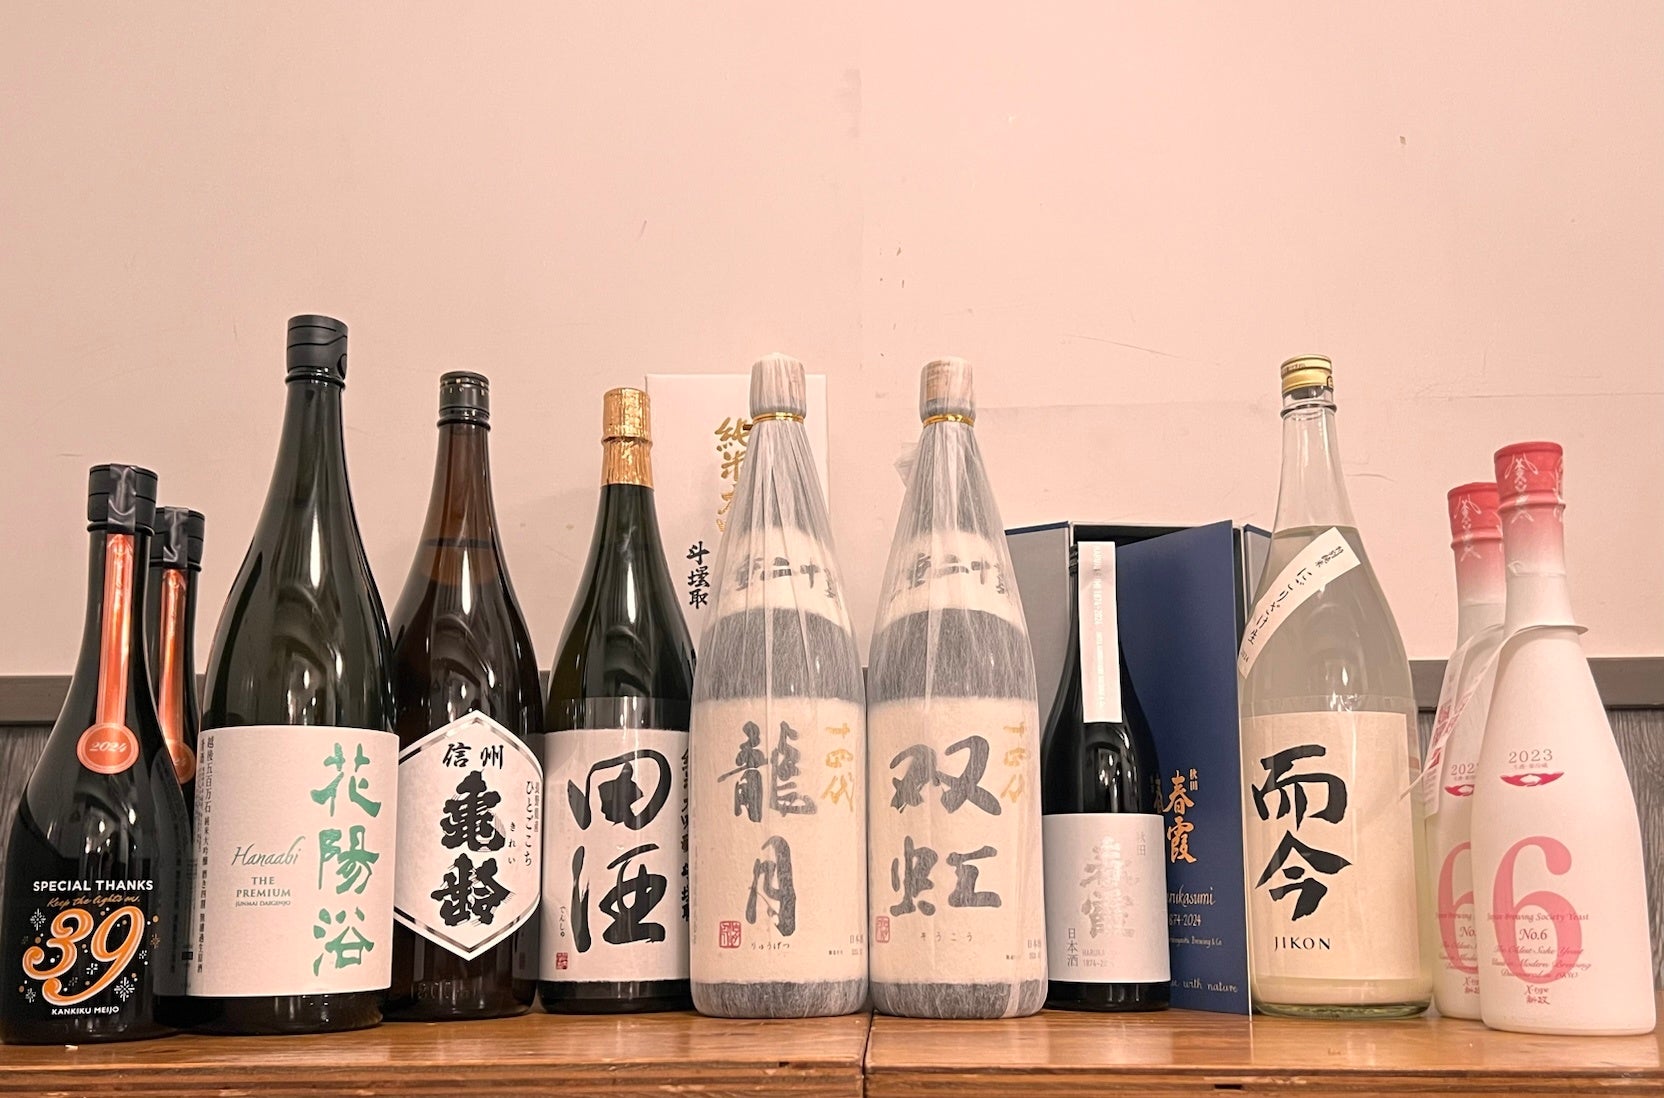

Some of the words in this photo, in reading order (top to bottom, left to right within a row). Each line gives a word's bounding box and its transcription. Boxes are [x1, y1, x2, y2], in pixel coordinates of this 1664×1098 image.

[89, 741, 129, 753] 2024
[442, 742, 505, 770] 信州
[1508, 748, 1553, 764] 2023
[1189, 768, 1199, 791] 秋田
[1451, 763, 1480, 776] 202
[888, 735, 1003, 918] 双虹
[1162, 769, 1198, 864] 春霞
[717, 720, 818, 937] 龍月
[1251, 744, 1353, 922] 而今
[231, 836, 306, 867] Hanaabi
[508, 821, 517, 865] きれい
[567, 748, 673, 954] 田酒
[310, 742, 382, 977] 花陽浴
[33, 880, 92, 892] SPECIAL
[95, 879, 154, 891] THANKS
[251, 876, 275, 885] THE
[46, 897, 71, 910] Keep
[72, 894, 93, 906] the
[92, 894, 123, 908] lights
[236, 889, 291, 898] PREMIUM
[1168, 913, 1202, 927] 874-2024
[1492, 835, 1583, 984] 6
[1274, 936, 1331, 950] JIKON
[1519, 928, 1548, 941] No.6
[22, 905, 146, 1006] 39
[1066, 927, 1079, 968] 日本酒
[1183, 977, 1202, 989] with
[1207, 981, 1238, 993] nature
[51, 1006, 92, 1016] KANKIKU
[93, 1005, 120, 1016] MEIJO
